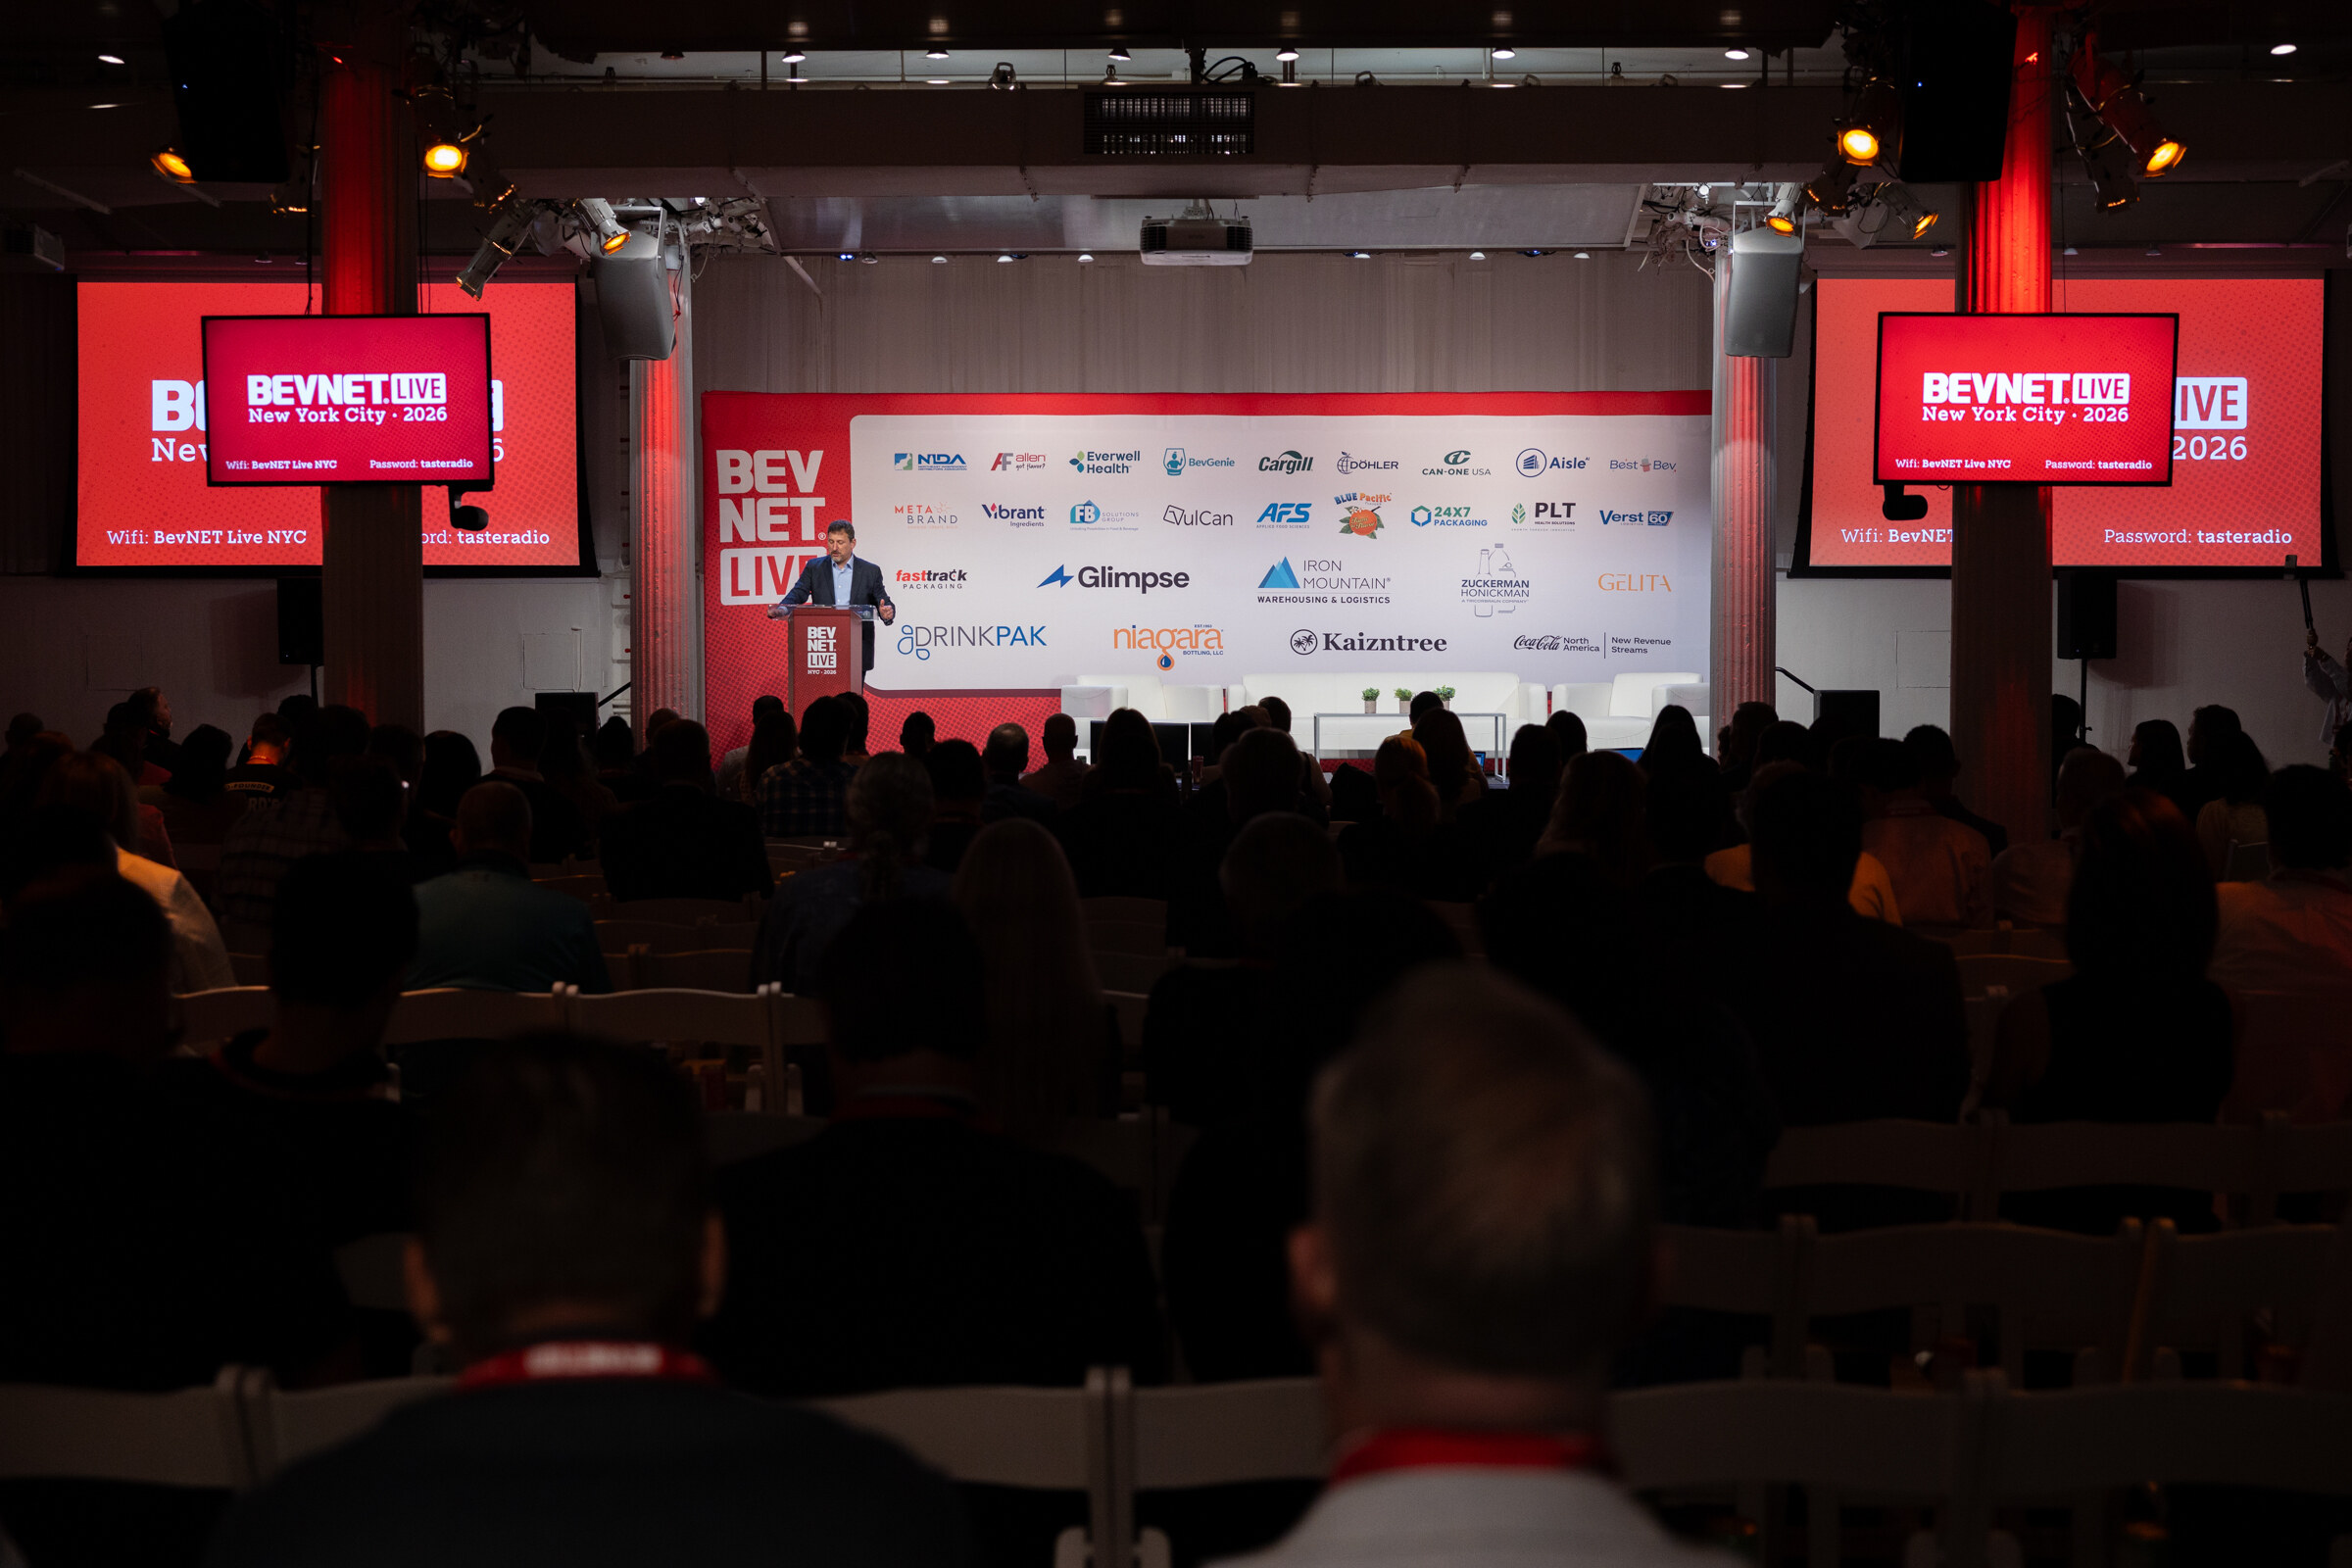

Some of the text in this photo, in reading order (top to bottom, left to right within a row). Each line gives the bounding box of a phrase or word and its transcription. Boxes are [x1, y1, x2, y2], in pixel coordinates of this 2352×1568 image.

[396, 377, 441, 400] LIVE
[2078, 378, 2125, 399] LIVE
[2175, 385, 2238, 421] IVE
[248, 407, 448, 425] New York City 2026
[1922, 407, 2130, 425] New York City 2026
[2173, 435, 2247, 461] 2026
[1015, 453, 1046, 462] allen
[1087, 450, 1141, 462] Everwell
[1189, 457, 1236, 467] BevGenie
[225, 460, 337, 469] Wifi: BevNET Live NYC
[369, 459, 473, 468] Password: tasteradio
[1087, 463, 1130, 474] Health
[1258, 456, 1314, 475] Cargill
[1349, 460, 1399, 469] DÖHLER
[1609, 460, 1677, 470] Best Bev
[1895, 459, 2011, 468] Wifi: BevNET Live NYC
[2045, 460, 2153, 469] Password: tasteradio
[715, 449, 824, 495] BEV
[1334, 492, 1358, 506] BLUE
[1359, 492, 1392, 503] Pacific
[894, 505, 933, 514] META
[981, 503, 1045, 519] Vibrant
[1075, 505, 1096, 522] FB
[1256, 503, 1312, 523] AFS
[1434, 506, 1471, 517] 24X7
[1535, 502, 1576, 518] PLT
[906, 515, 958, 524] BRAND
[1599, 510, 1668, 525] Verst 60
[107, 529, 307, 545] Wifi: BevNET Live NYC
[457, 529, 550, 545] tasteradio
[1840, 528, 1883, 543] Wifi:
[2104, 529, 2292, 544] Password: tasteradio
[1303, 560, 1342, 572] IRON
[896, 569, 968, 582] fasttrack
[1078, 565, 1190, 594] Glimpse
[1461, 579, 1530, 589] ZUCKERMAN
[1598, 573, 1672, 593] GELITA
[1461, 589, 1530, 598] HONICKMAN
[808, 626, 837, 639] BEV
[915, 625, 1048, 647] DRINKPAK
[1323, 631, 1447, 652] Kaizntree
[1563, 644, 1600, 653] America
[810, 655, 834, 666] LIVE
